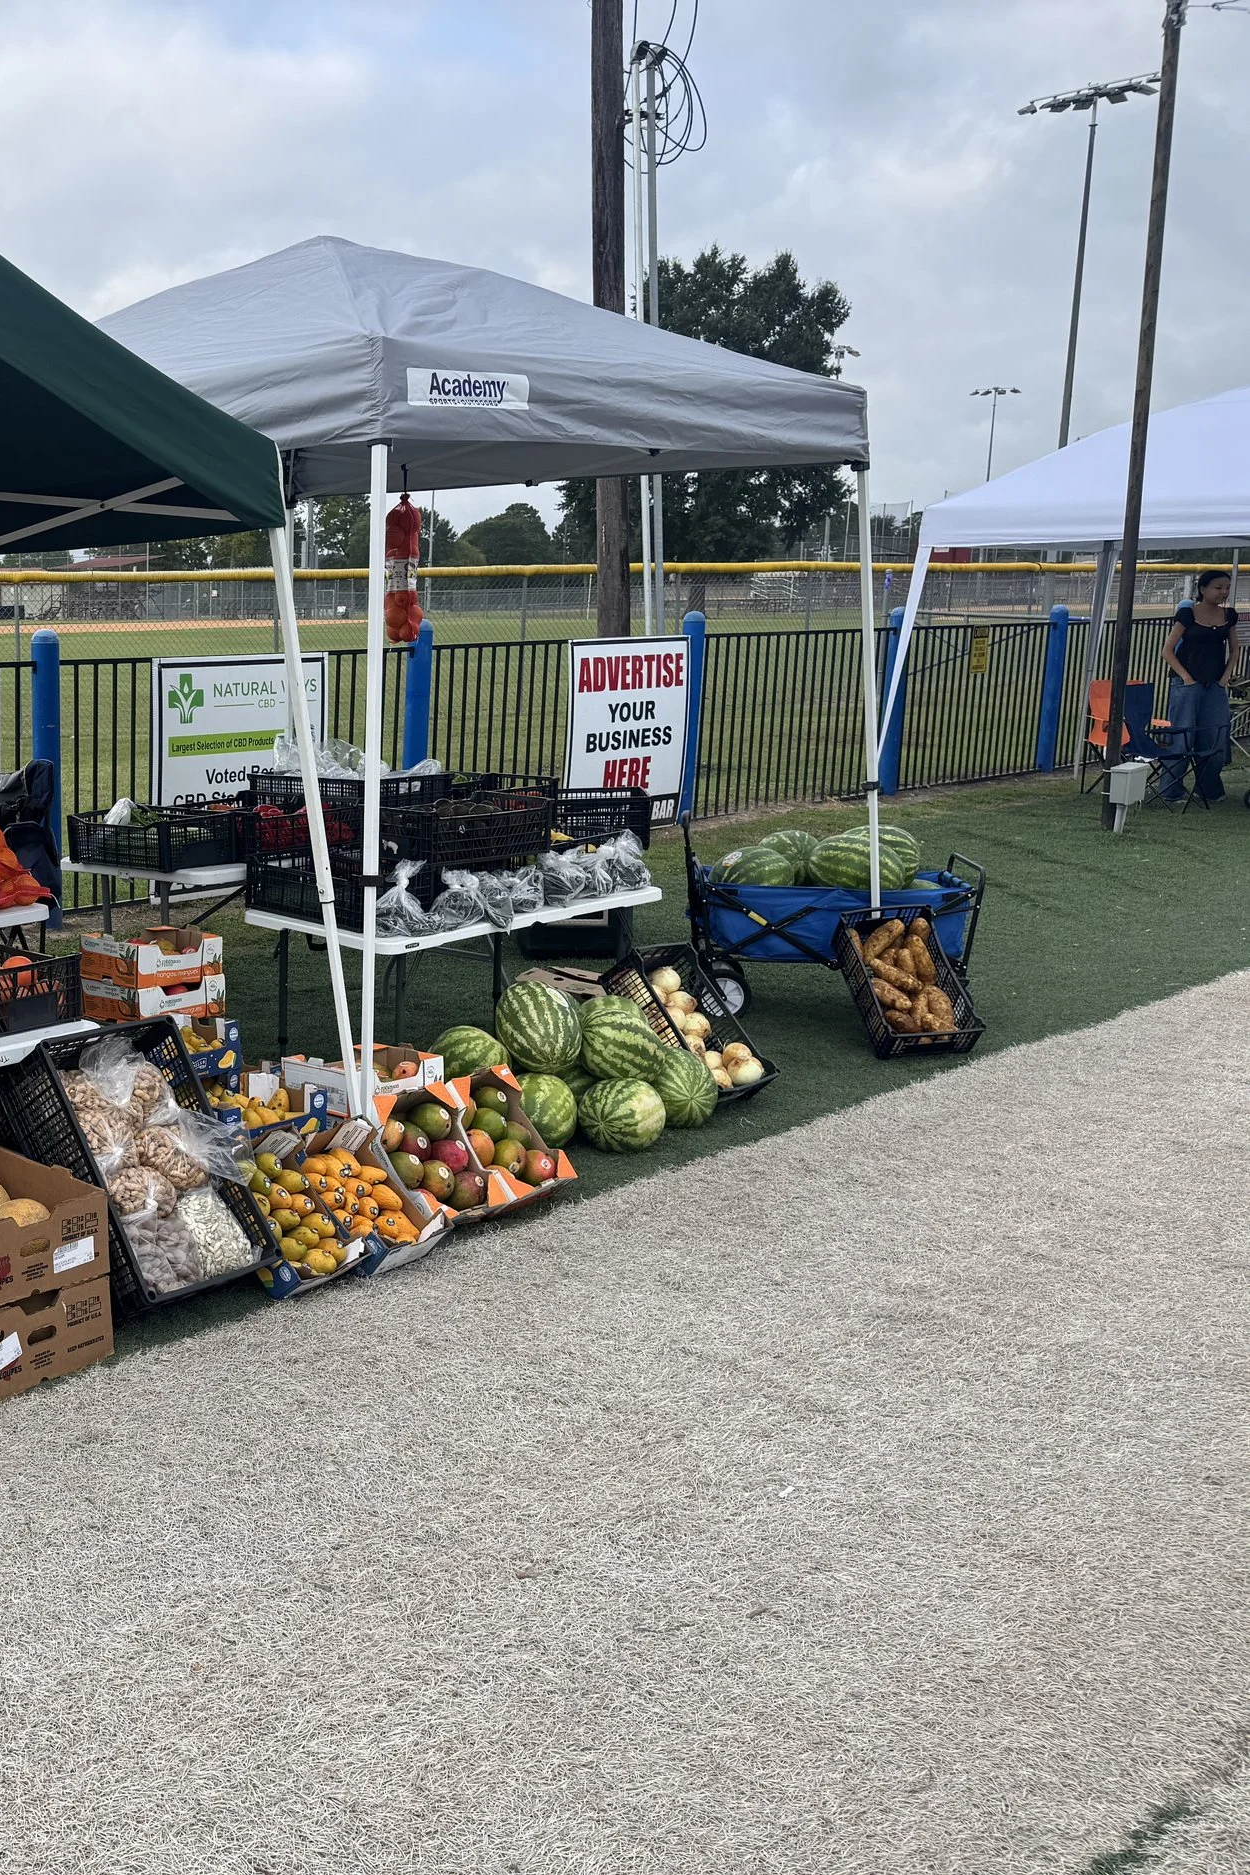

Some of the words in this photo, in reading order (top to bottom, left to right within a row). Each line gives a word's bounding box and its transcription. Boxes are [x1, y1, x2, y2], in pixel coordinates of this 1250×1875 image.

[429, 372, 506, 404] Academy
[578, 653, 684, 693] ADVERTISE
[213, 680, 277, 698] NATURAL
[258, 698, 275, 709] CBD
[608, 701, 656, 723] YOUR
[171, 742, 196, 754] Largest
[196, 739, 225, 751] Selection
[226, 738, 233, 748] of
[233, 737, 247, 748] CBD
[249, 736, 274, 746] Products
[586, 725, 673, 753] BUSINESS
[205, 766, 247, 785] Voted
[603, 756, 652, 789] HERE
[650, 799, 675, 821] BAR
[61, 1233, 80, 1242] PRODUCT
